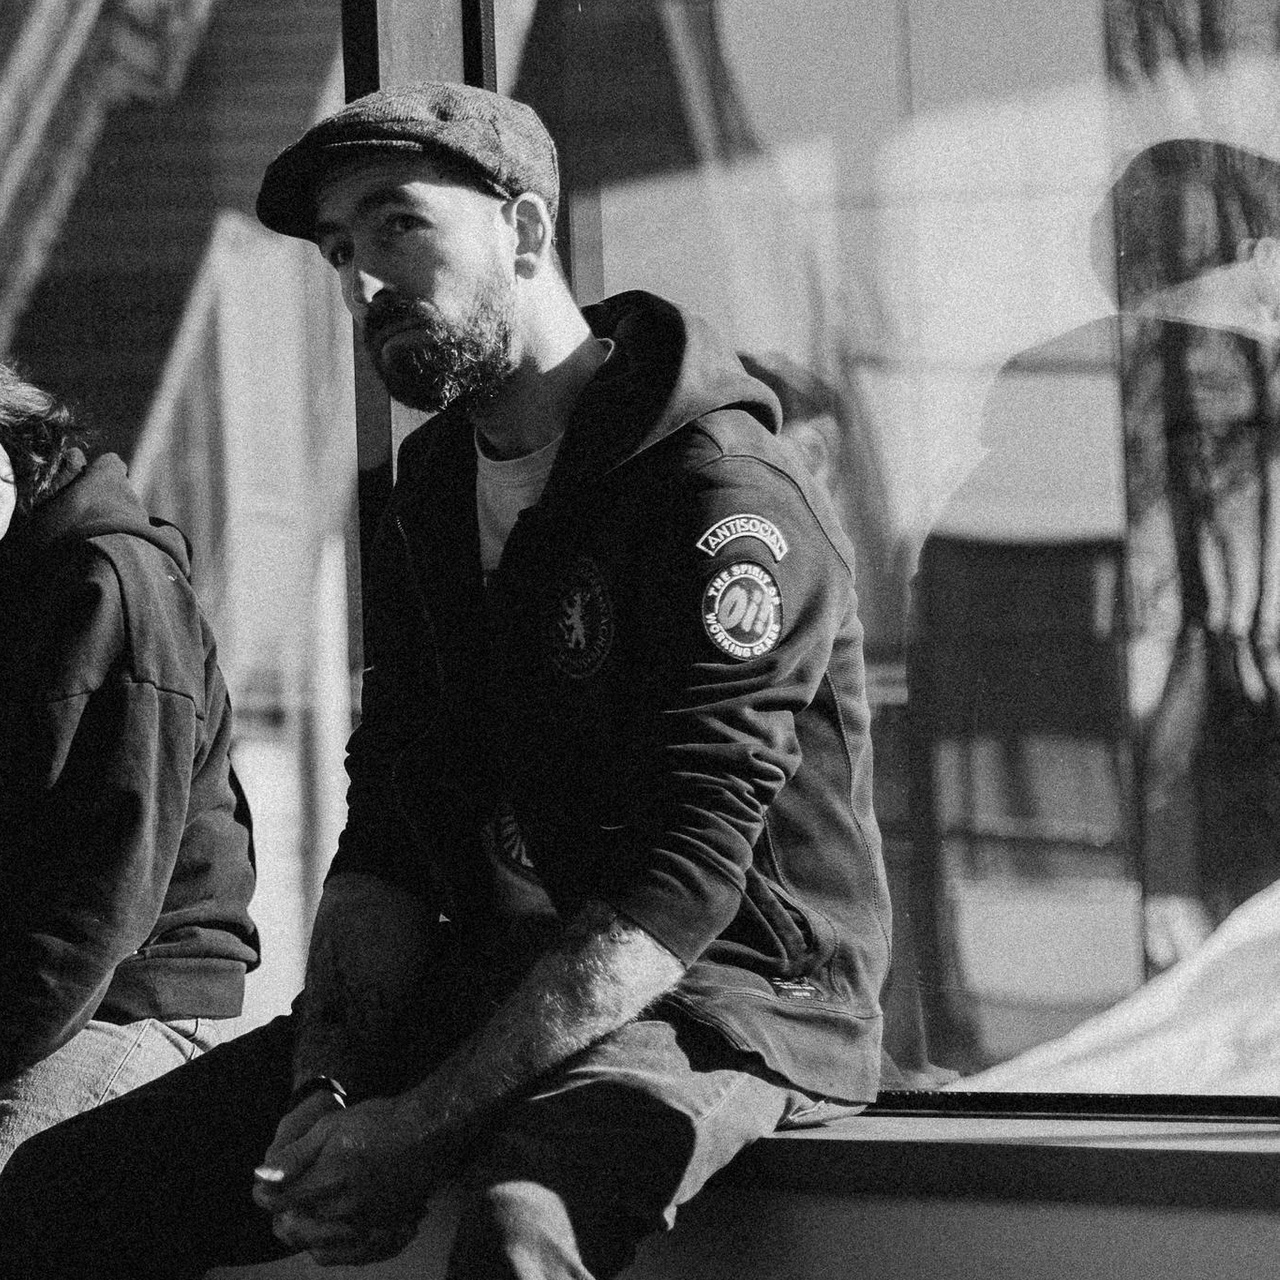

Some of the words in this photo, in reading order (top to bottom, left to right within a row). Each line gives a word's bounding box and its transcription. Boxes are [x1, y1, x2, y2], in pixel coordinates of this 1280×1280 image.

[707, 570, 731, 597] THE
[730, 564, 771, 584] SPIRIT
[705, 612, 751, 657] WORKING
